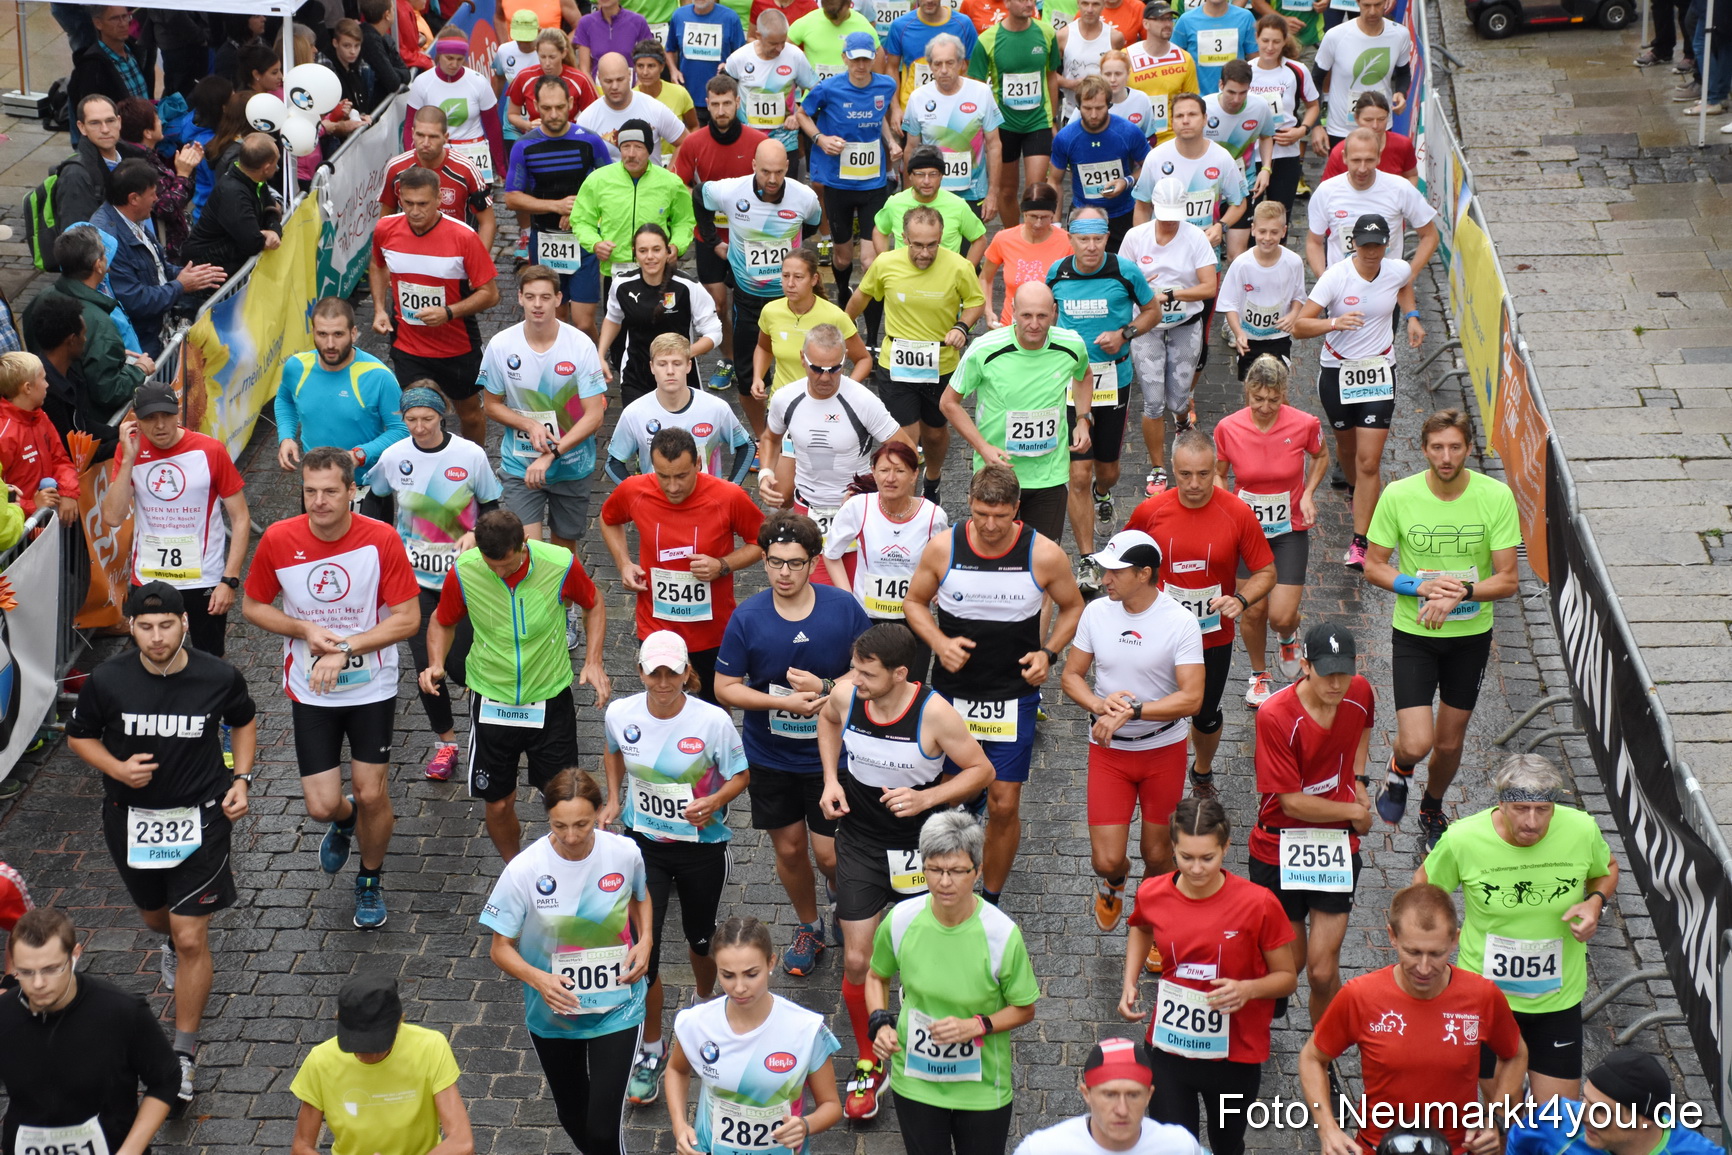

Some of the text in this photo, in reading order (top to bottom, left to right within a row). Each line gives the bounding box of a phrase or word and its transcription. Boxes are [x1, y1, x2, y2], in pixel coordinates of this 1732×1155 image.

[688, 32, 717, 47] 2471
[1215, 39, 1222, 52] 3
[1134, 67, 1187, 82] MAX BÖGL
[1008, 81, 1038, 96] 2317
[754, 102, 777, 115] 101
[847, 111, 873, 119] JESUS
[850, 151, 875, 166] 600
[945, 162, 968, 176] 049
[1085, 168, 1121, 186] 2919
[1186, 200, 1212, 217] 077
[542, 243, 575, 258] 2841
[402, 292, 441, 310] 2089
[1064, 299, 1108, 310] HUBER
[1245, 309, 1280, 327] 3093
[896, 350, 933, 367] 3001
[1345, 367, 1386, 387] 3091
[1012, 420, 1055, 439] 2513
[1019, 442, 1048, 451] Manfred
[1248, 504, 1286, 522] 512
[157, 549, 182, 567] 78
[669, 550, 685, 558] DEHN
[657, 582, 706, 602] 2546
[671, 606, 691, 615] Adolf
[1449, 605, 1474, 615] opher
[1119, 638, 1142, 646] skinfit
[497, 709, 529, 720] Thomas
[968, 700, 1006, 720] 259
[121, 713, 206, 738] THULE
[783, 722, 817, 733] Christop
[970, 724, 1002, 734] Maurice
[681, 742, 702, 750] Hervis
[639, 792, 688, 820] 3095
[136, 820, 194, 844] 2332
[150, 849, 181, 860] Patrick
[1288, 844, 1346, 868] 2554
[602, 878, 621, 888] Hervis
[1288, 872, 1345, 884] Julius Maria
[587, 949, 623, 960] BOCK
[1187, 968, 1204, 976] DEHN
[1493, 954, 1556, 978] 3054
[561, 962, 621, 991] 3061
[1162, 999, 1223, 1033] 2269
[1370, 1023, 1393, 1033] Spitz
[1168, 1033, 1211, 1050] Christine
[769, 1058, 794, 1068] Hervis
[928, 1062, 957, 1074] Ingrid
